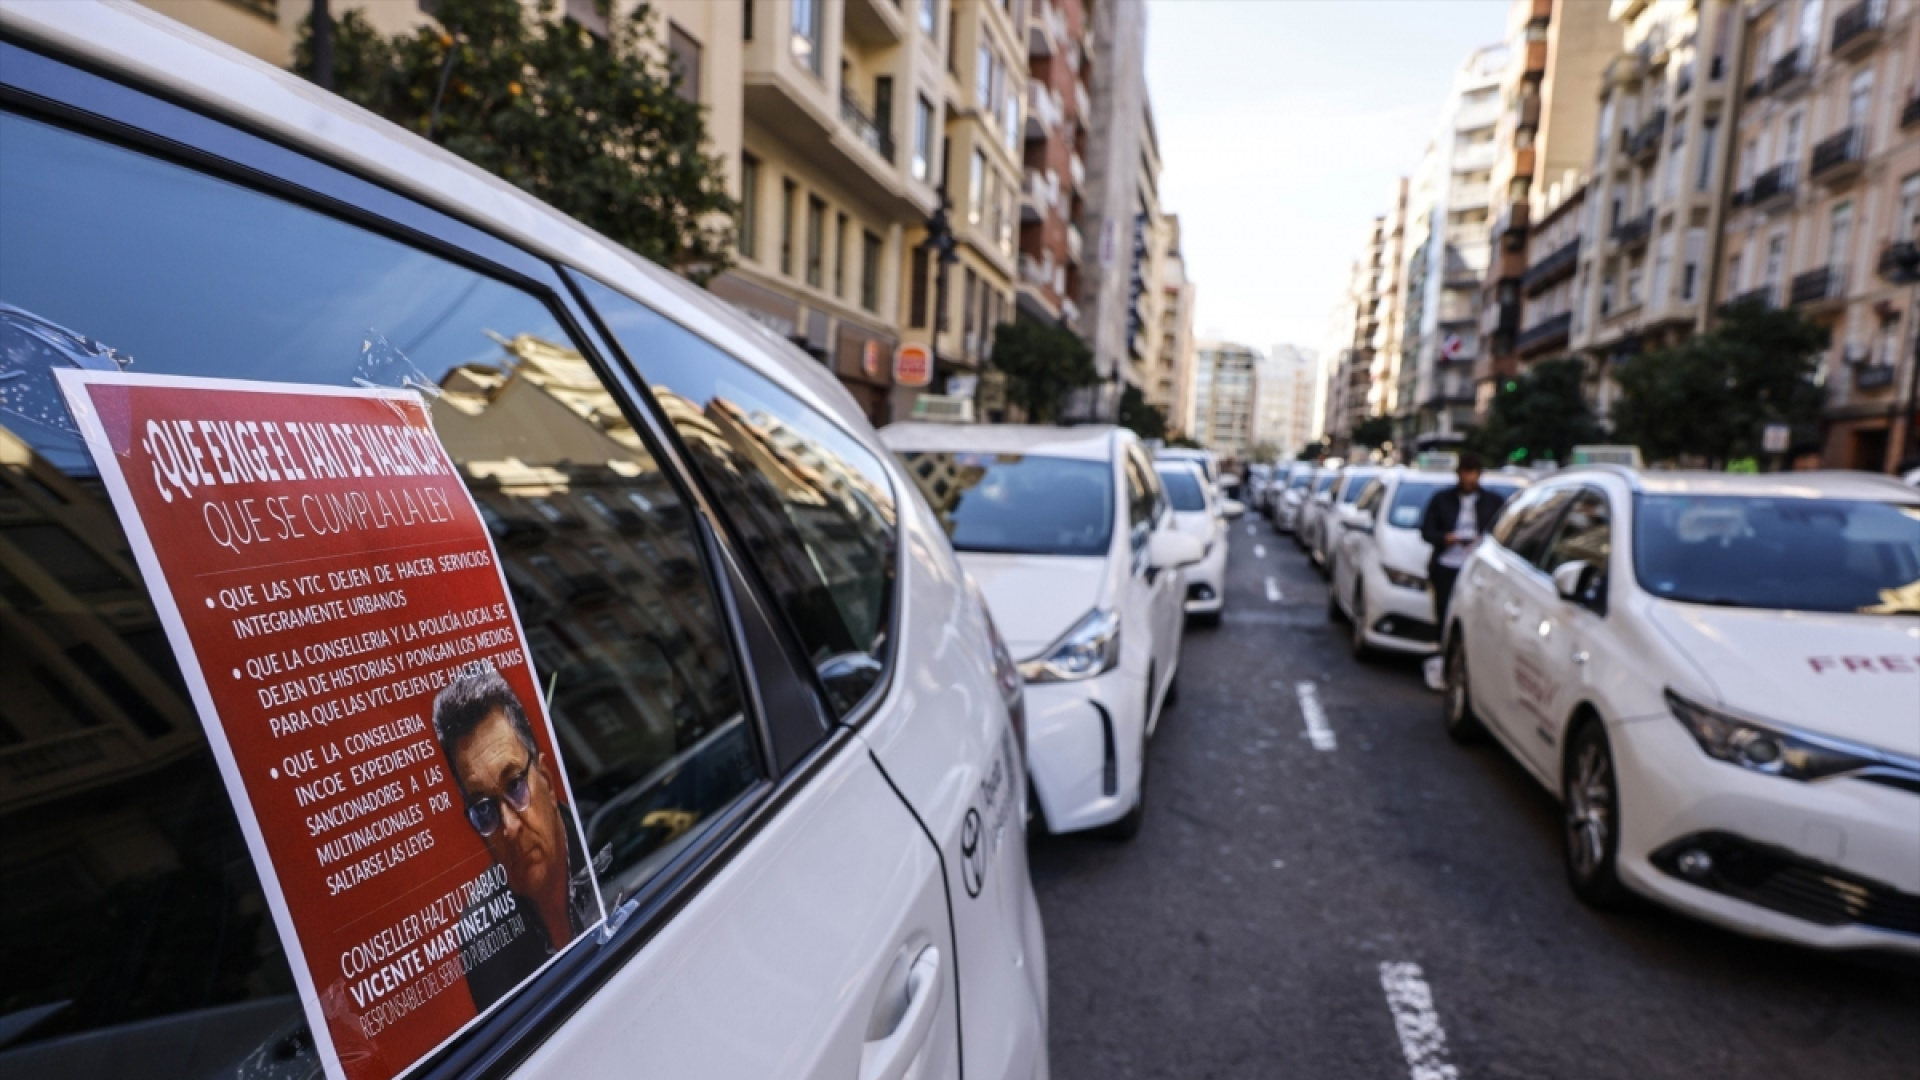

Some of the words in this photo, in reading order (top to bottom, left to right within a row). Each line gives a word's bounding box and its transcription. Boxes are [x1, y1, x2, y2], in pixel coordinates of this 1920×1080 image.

[142, 419, 216, 503] ¿QUE
[197, 420, 282, 484] EXIGE
[261, 421, 307, 481] EL
[285, 421, 349, 479] TAXI
[329, 423, 375, 478] DE
[203, 501, 271, 554] QUE
[266, 496, 305, 540] SE
[302, 490, 399, 536] CUMPLA
[390, 488, 425, 526] LA
[416, 487, 455, 523] LEY
[219, 585, 258, 611] QUE
[261, 580, 292, 602] LAS
[293, 574, 325, 596] VTC
[328, 567, 372, 591] DEJEN
[374, 564, 394, 583] DE
[396, 557, 436, 579] HACER
[438, 550, 491, 572] SERVICIOS
[232, 600, 347, 639] INTEGRAMENTE
[347, 589, 407, 616] URBANOS
[246, 653, 282, 680] QUE
[282, 649, 304, 670] LA
[304, 629, 392, 664] CONSELLERIA
[390, 626, 400, 643] Y
[401, 622, 419, 642] LA
[419, 609, 462, 638] POLICÍA
[461, 606, 493, 628] LOCAL
[493, 603, 507, 621] SE
[258, 679, 308, 709] DEJEN
[308, 673, 330, 695] DE
[330, 656, 396, 689] HISTORIAS
[394, 653, 404, 671] Y
[406, 641, 455, 669] PONGAN
[454, 636, 475, 655] LOS
[475, 626, 514, 650] MEDIOS
[1806, 655, 1920, 674] FRE
[269, 709, 313, 738] PARA
[311, 700, 343, 726] QUE
[341, 693, 367, 716] LAS
[365, 685, 393, 708] VTC
[392, 675, 430, 700] DEJEN
[429, 669, 447, 689] DE
[446, 660, 484, 685] HACER
[481, 655, 497, 674] DE
[494, 648, 523, 669] TAXIS
[282, 749, 318, 778] QUE
[320, 742, 342, 764] LA
[344, 713, 426, 755] CONSELLERIA
[294, 771, 347, 807] INCOE
[349, 738, 435, 786] EXPEDIENTES
[306, 780, 406, 837] SANCIONADORES
[410, 775, 420, 794] A
[423, 764, 444, 787] LAS
[316, 803, 424, 867] MULTINACIONALES
[428, 791, 452, 815] POR
[326, 852, 387, 896] SALTARSE
[383, 842, 406, 868] LAS
[404, 828, 435, 858] LEYES
[341, 914, 423, 979] CONSELLER
[420, 898, 449, 934] HAZ
[444, 888, 463, 917] TU
[460, 863, 508, 908] TRABAJO
[350, 948, 424, 1008] VICENTE
[422, 906, 492, 966] MARTINEZ
[488, 890, 516, 923] MUS
[360, 980, 427, 1040] RESPONSABLE
[422, 971, 443, 999] DEL
